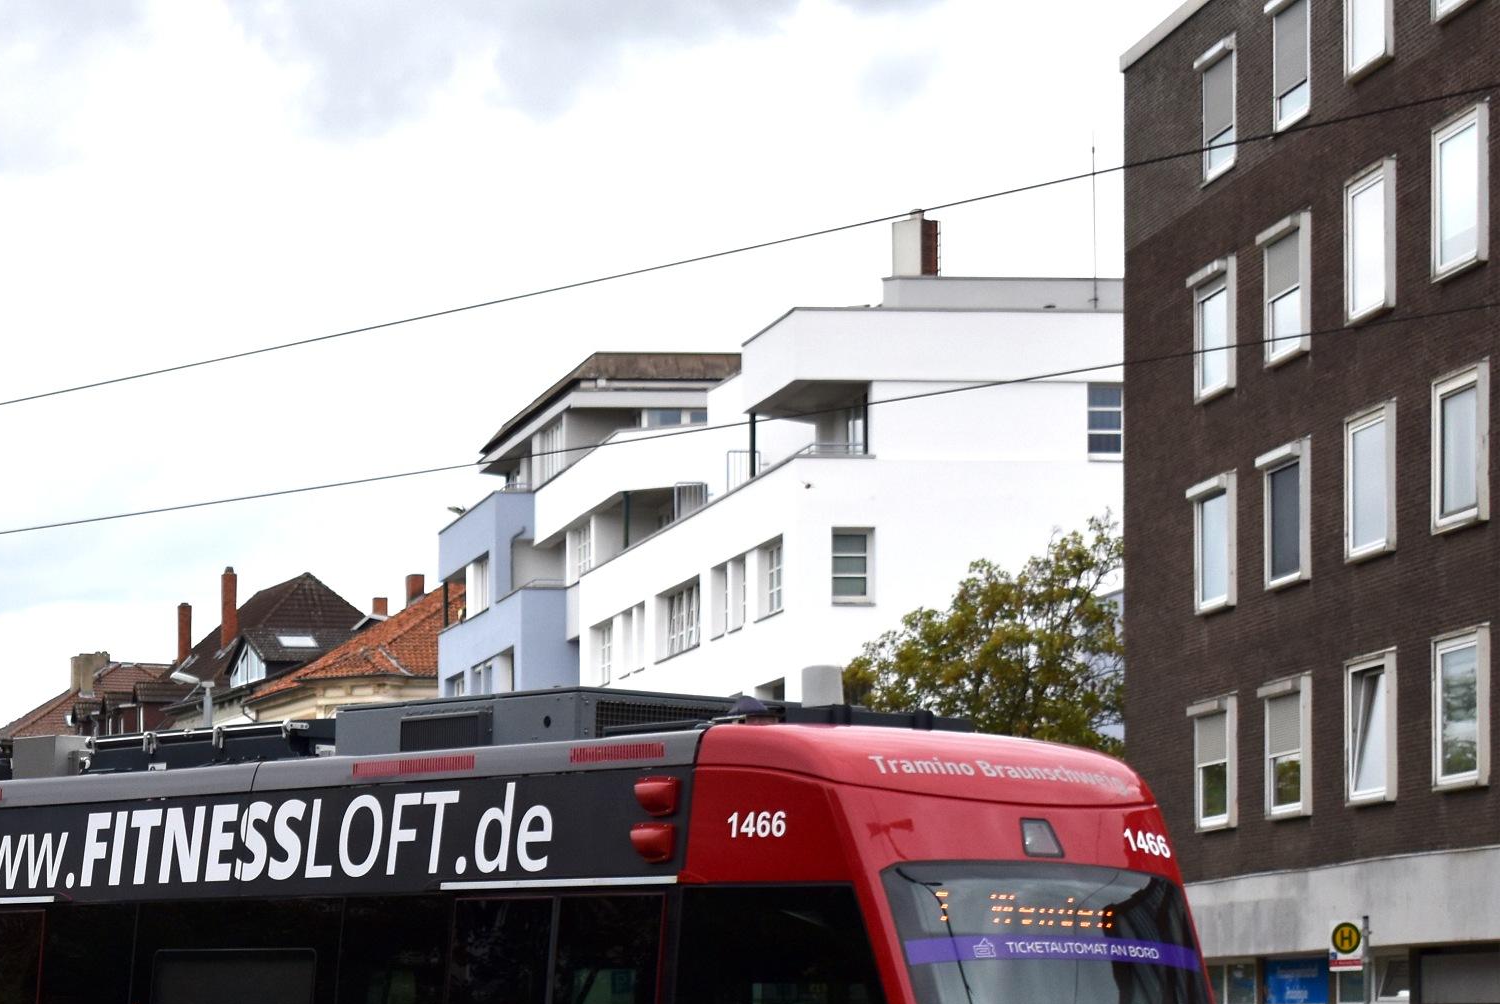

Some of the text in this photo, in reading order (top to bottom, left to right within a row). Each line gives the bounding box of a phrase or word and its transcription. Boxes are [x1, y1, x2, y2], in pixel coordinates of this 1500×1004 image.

[868, 754, 1132, 797] Tramino Braunschweig
[727, 810, 787, 838] 1466
[1123, 827, 1172, 859] 1466
[1005, 940, 1160, 960] TICKETAUTOMAT AN BORD
